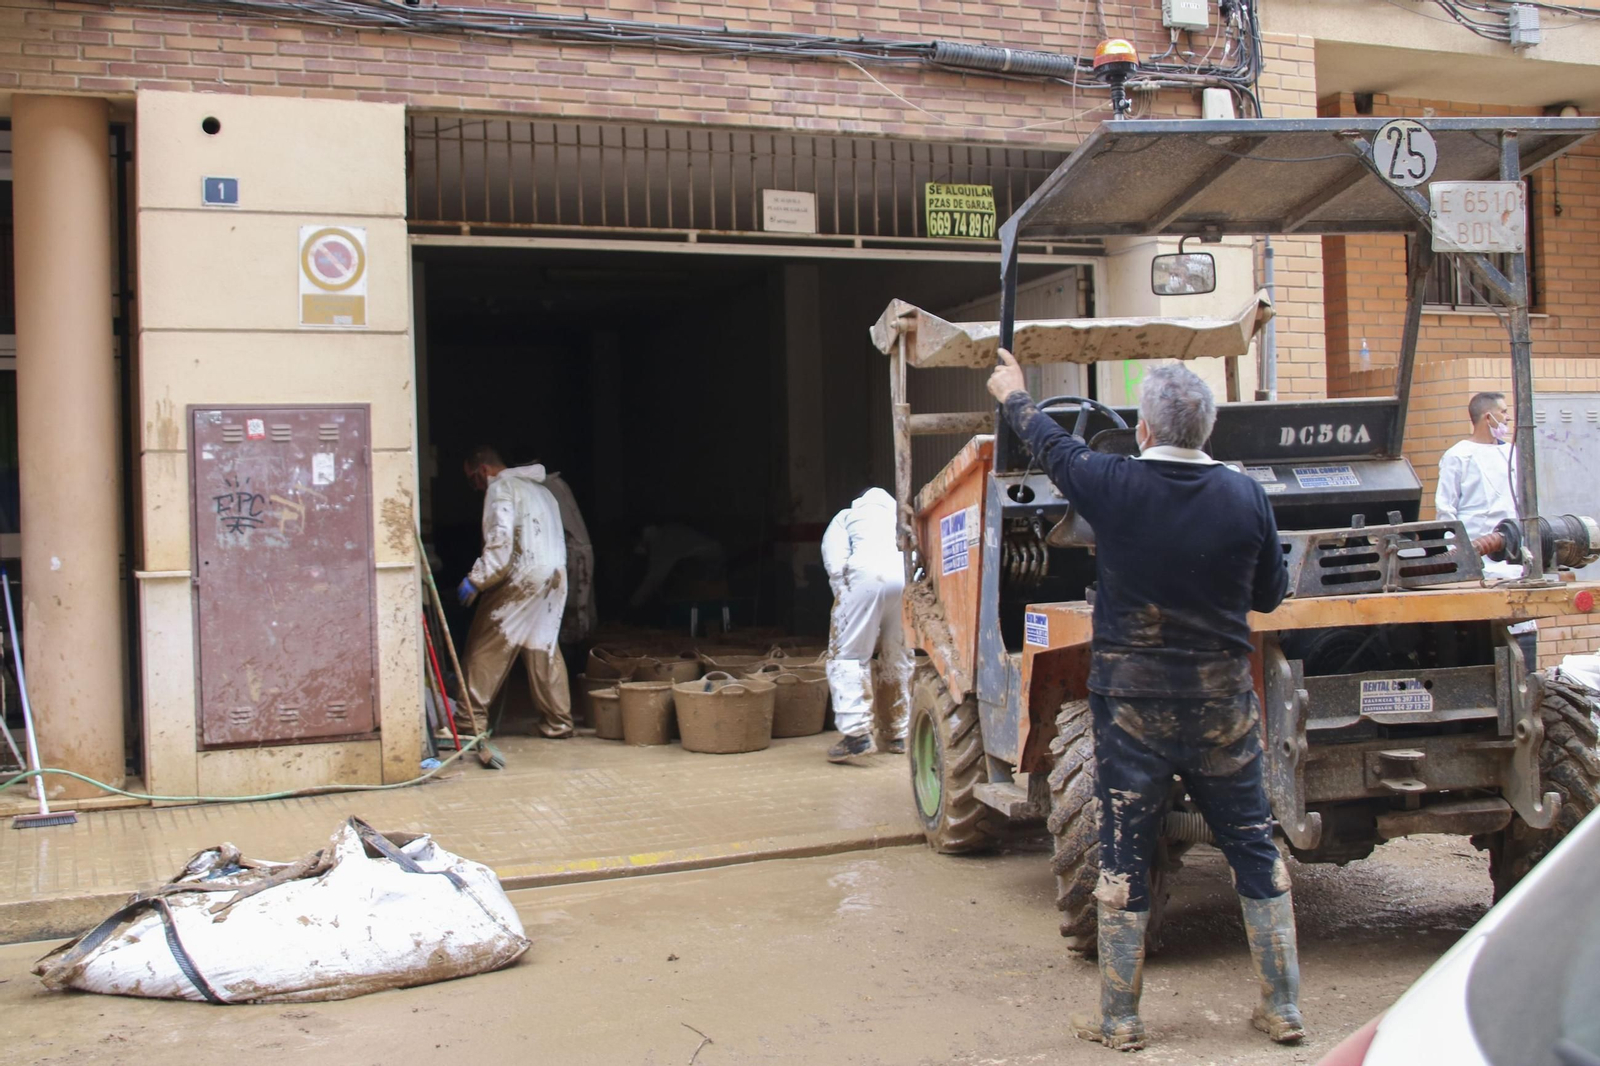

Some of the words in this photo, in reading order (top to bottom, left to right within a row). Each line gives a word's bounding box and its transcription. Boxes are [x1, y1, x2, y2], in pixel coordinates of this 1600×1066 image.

[1386, 125, 1426, 180] 25
[217, 182, 225, 200] 1
[929, 185, 942, 194] SE
[945, 186, 993, 198] ALQUILAN
[1440, 190, 1451, 213] E
[1463, 190, 1517, 213] 6510
[929, 198, 951, 208] PZAS
[953, 198, 964, 209] DE
[965, 199, 993, 211] GARAJE
[930, 211, 951, 235] 669
[953, 212, 967, 236] 74
[969, 213, 982, 237] 89
[982, 213, 994, 238] 61
[1457, 222, 1499, 245] BDL
[1279, 423, 1371, 446] DC56A
[1363, 681, 1389, 692] RENTAL
